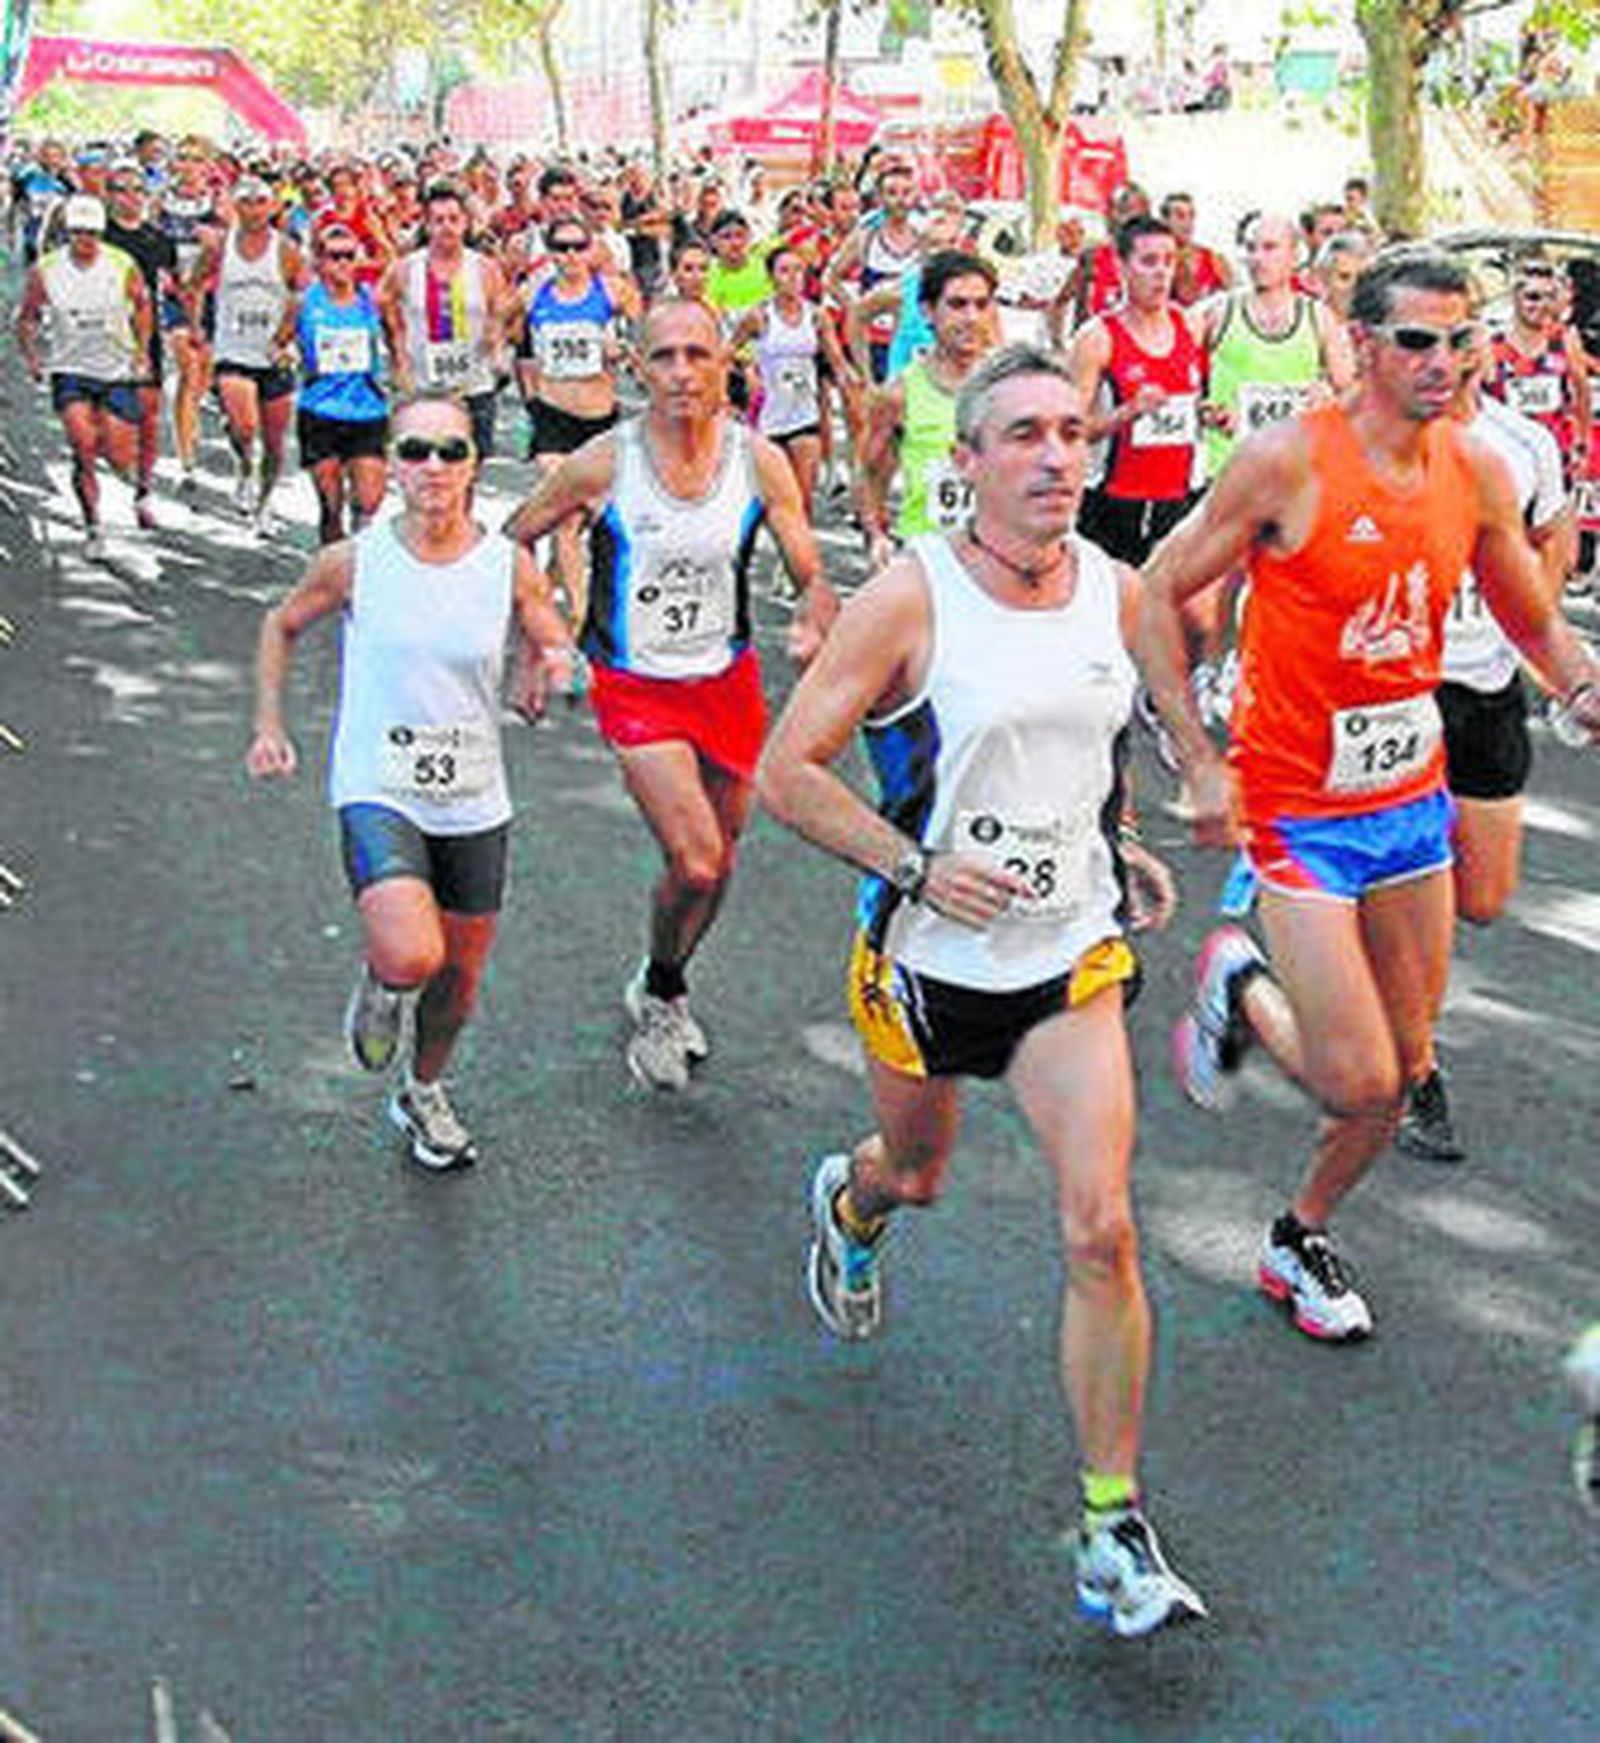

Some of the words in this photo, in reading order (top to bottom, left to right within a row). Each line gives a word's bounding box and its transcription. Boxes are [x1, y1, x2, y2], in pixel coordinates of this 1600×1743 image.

[662, 601, 701, 634] 37
[413, 752, 456, 785] 53
[1357, 732, 1420, 775] 134
